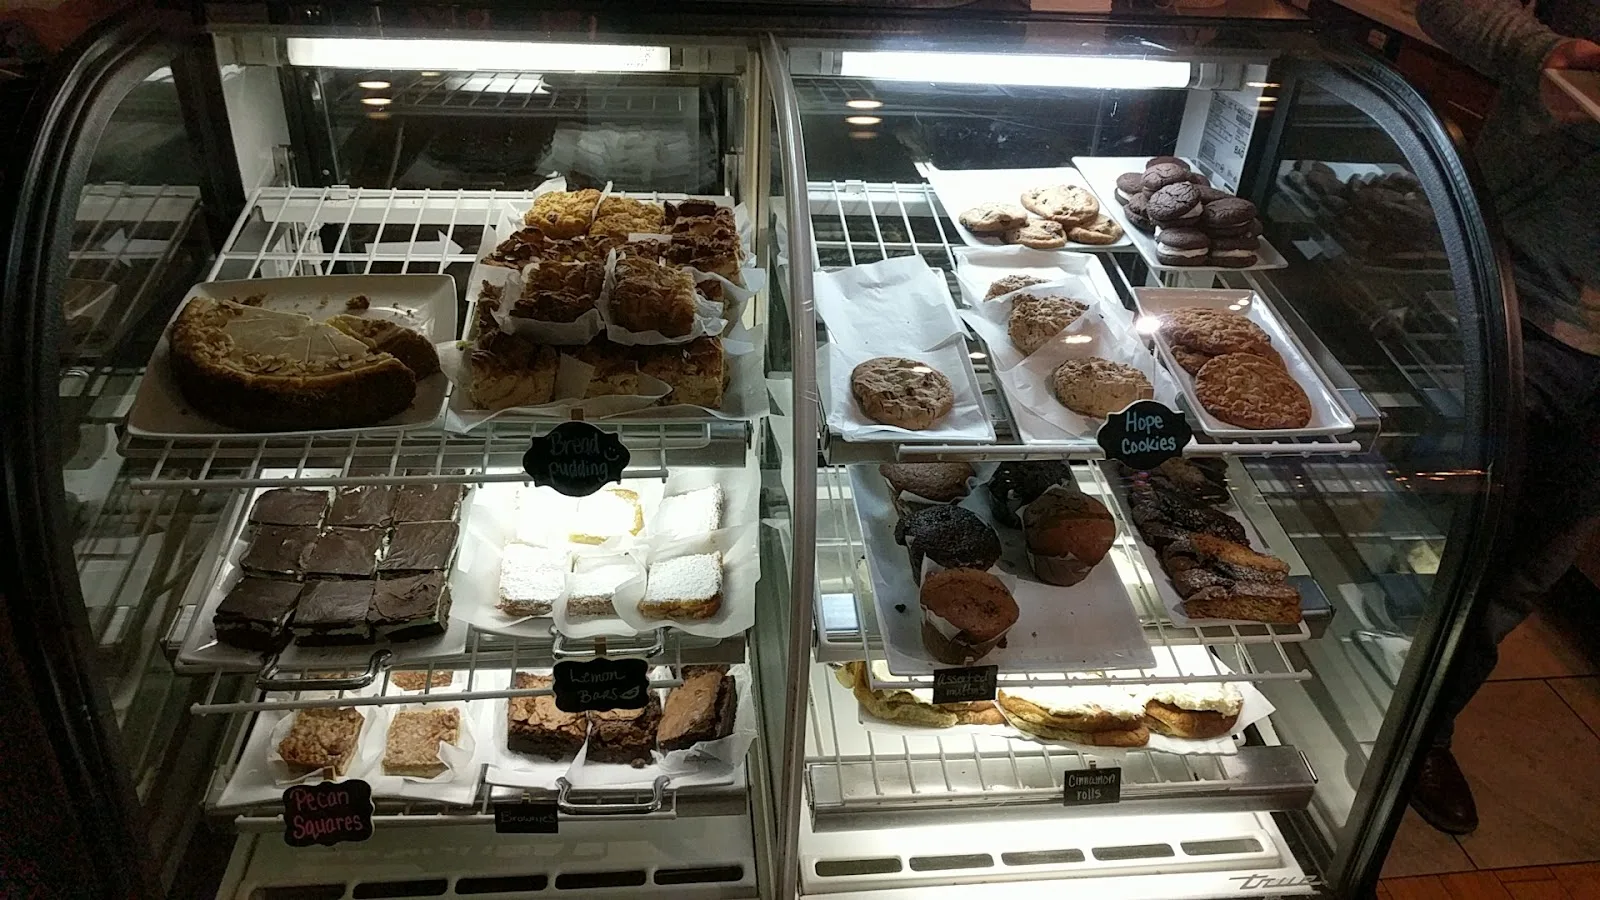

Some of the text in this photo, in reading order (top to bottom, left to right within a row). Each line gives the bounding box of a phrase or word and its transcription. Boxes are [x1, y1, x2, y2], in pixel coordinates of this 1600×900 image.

[1125, 411, 1164, 434] Hope
[548, 431, 601, 456] Bread
[1121, 435, 1176, 455] Cookies
[548, 460, 608, 486] pudding
[570, 668, 626, 683] Lemon
[1068, 773, 1116, 788] Cinnamon
[289, 788, 349, 811] Pecan
[1077, 787, 1101, 801] rolls
[293, 815, 363, 840] Squares
[1229, 874, 1322, 890] true
